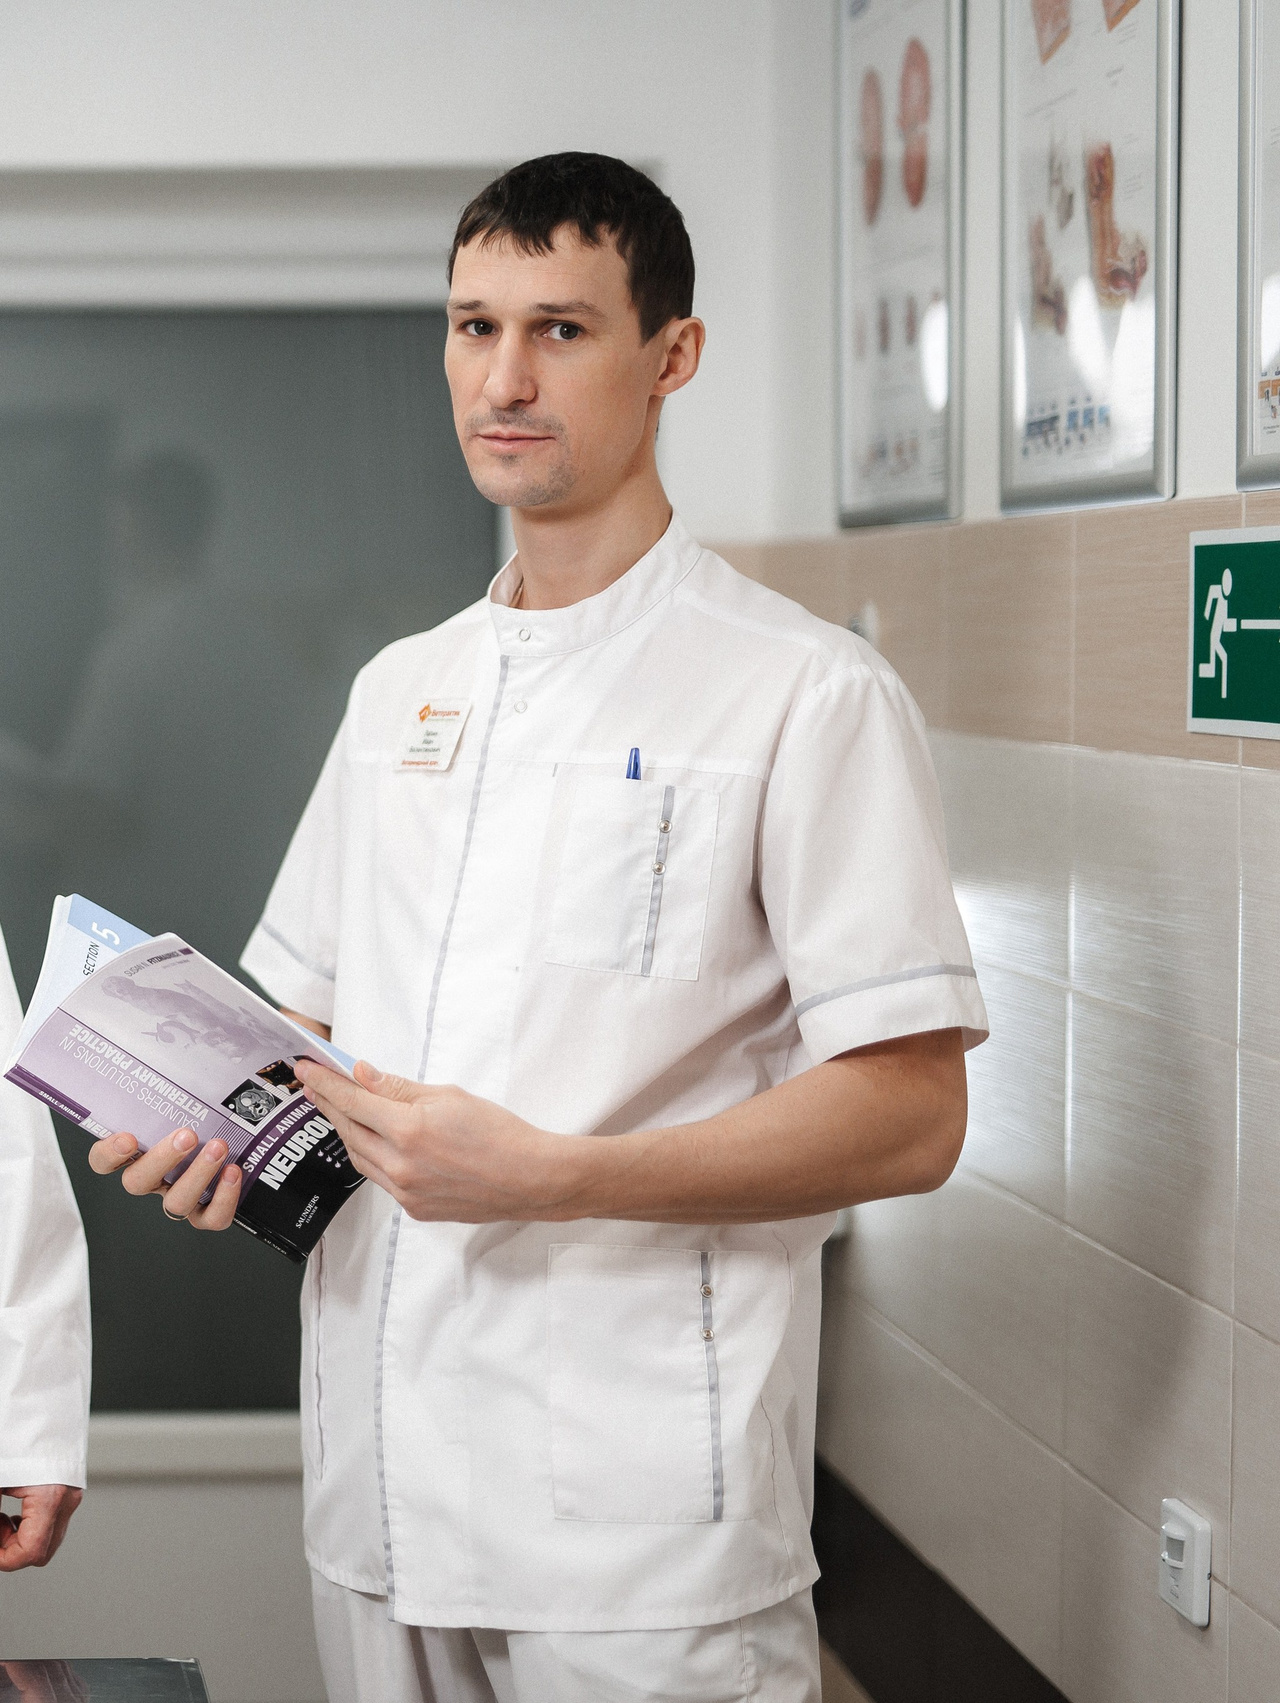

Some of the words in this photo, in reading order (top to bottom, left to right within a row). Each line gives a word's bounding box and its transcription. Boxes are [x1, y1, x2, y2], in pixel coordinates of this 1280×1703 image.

[82, 941, 100, 976] SECTION
[91, 921, 121, 946] 5
[58, 1036, 75, 1052] IN
[69, 1023, 133, 1071] PRACTICE
[73, 1045, 139, 1093] SOLUTIONS
[39, 1090, 59, 1106] SMALL
[59, 1103, 82, 1121] ANIMAL
[130, 1068, 210, 1122] VETERINARY
[136, 1087, 200, 1132] SAUNDERS
[242, 1134, 279, 1173] SMALL
[276, 1101, 317, 1135] ANIMAL
[295, 1194, 320, 1229] SAUNDERS
